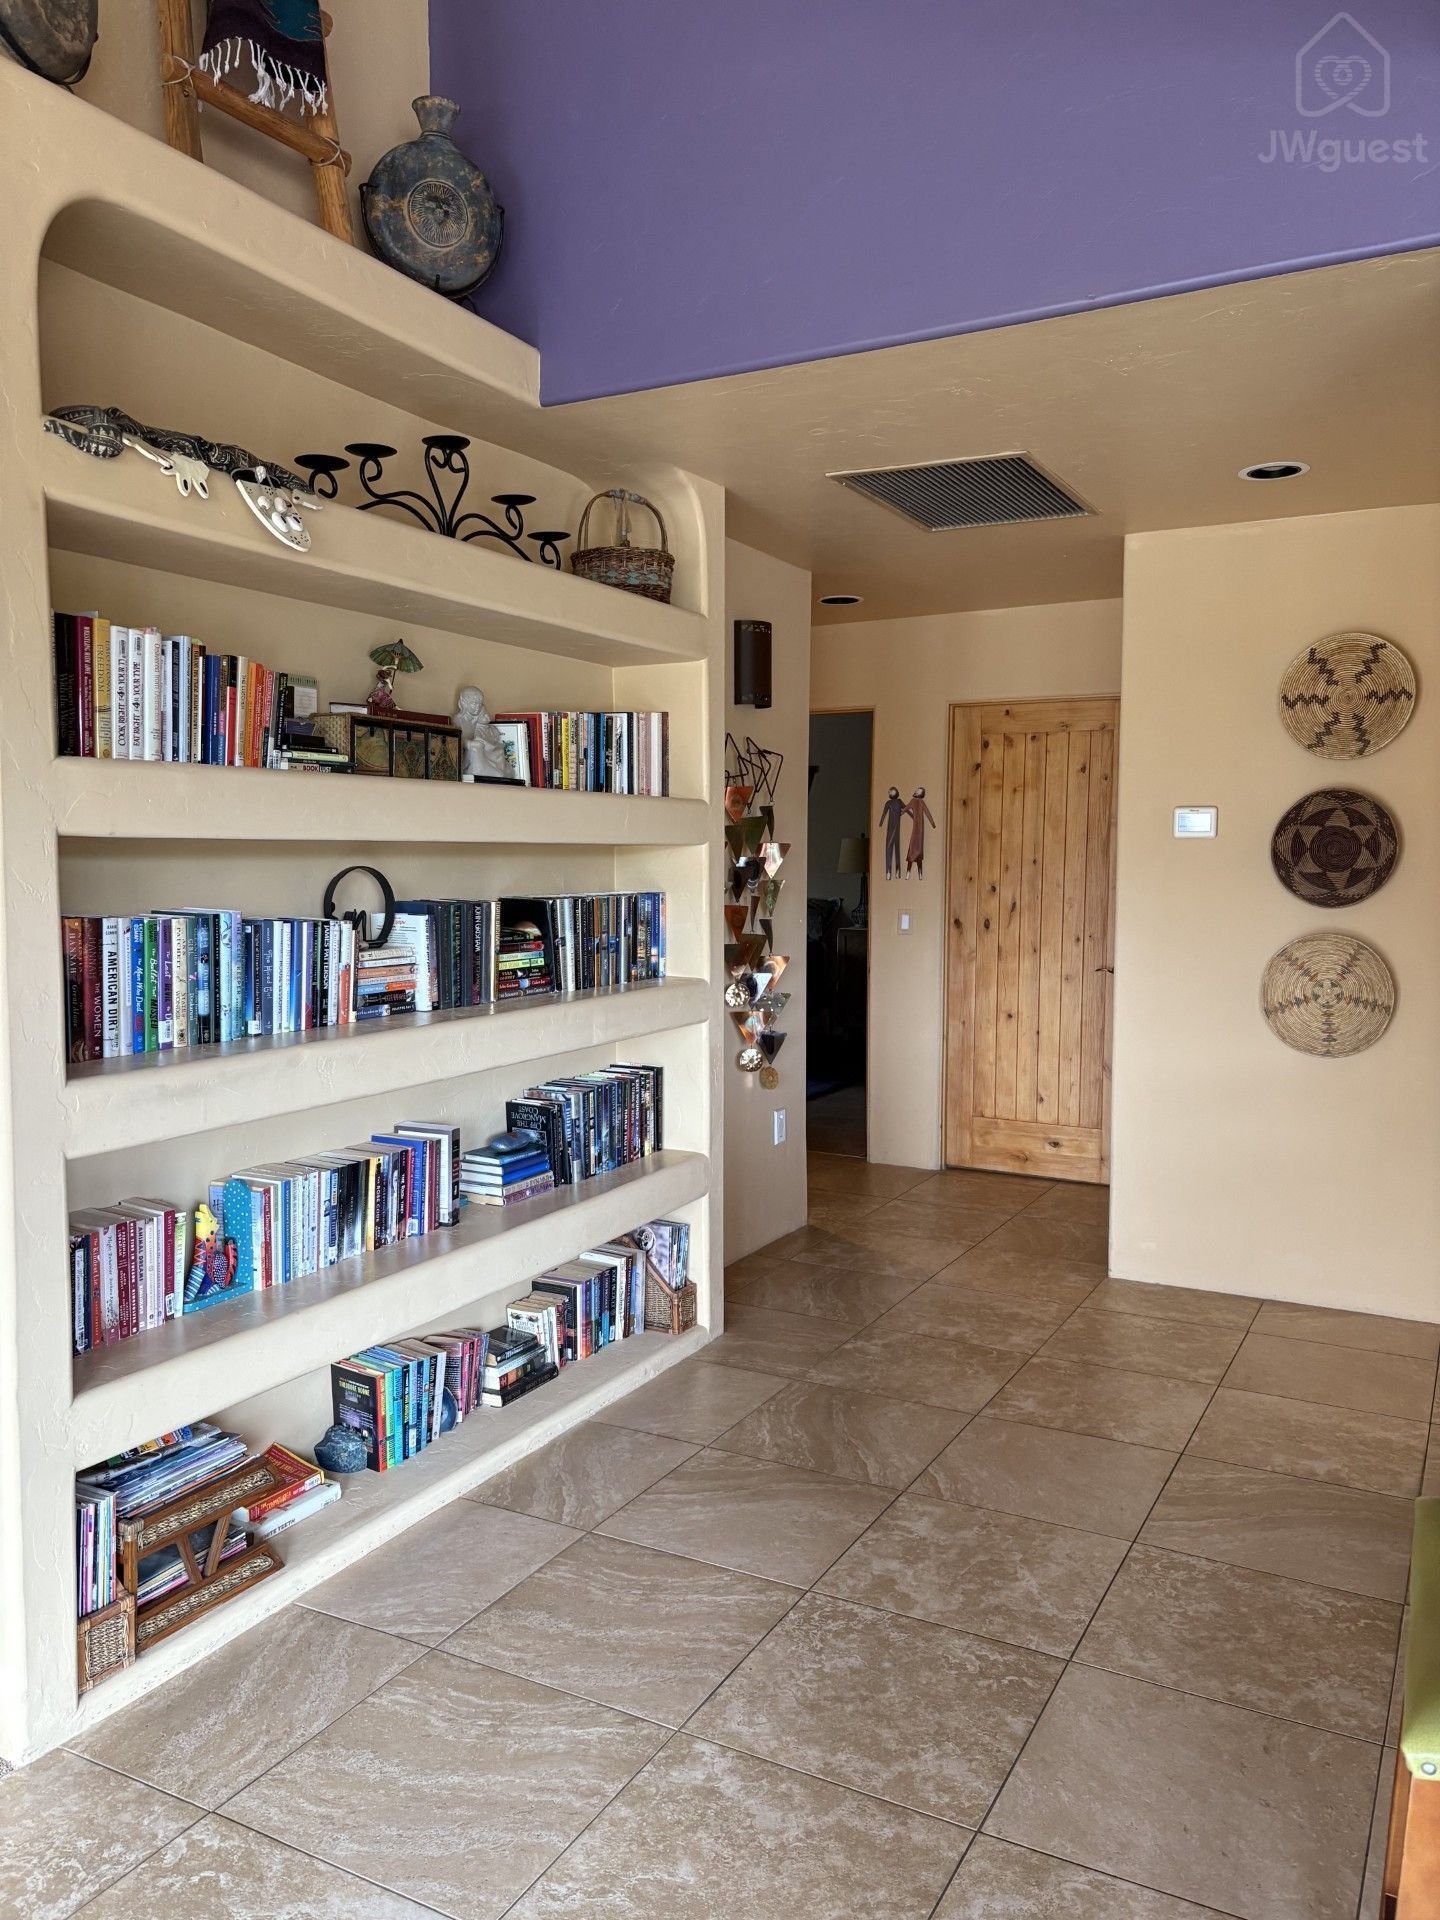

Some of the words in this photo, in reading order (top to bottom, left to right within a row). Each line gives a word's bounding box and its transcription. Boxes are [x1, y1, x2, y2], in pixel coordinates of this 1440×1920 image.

[133, 714, 141, 734] RIGHT
[118, 725, 126, 746] COOK
[133, 734, 141, 746] EAT
[474, 923, 482, 952] GRISHAM
[69, 932, 77, 974] HANNAH
[89, 937, 97, 979] HANNAH
[107, 951, 117, 1006] AMERICAN
[134, 966, 143, 981] Man
[264, 965, 272, 984] Hired
[93, 995, 101, 1038] WOMEN
[107, 1008, 119, 1031] DIRT
[511, 1112, 546, 1123] MANGROVE
[519, 1106, 538, 1115] COAST
[517, 1120, 528, 1128] THE
[277, 1517, 296, 1533] TEETH
